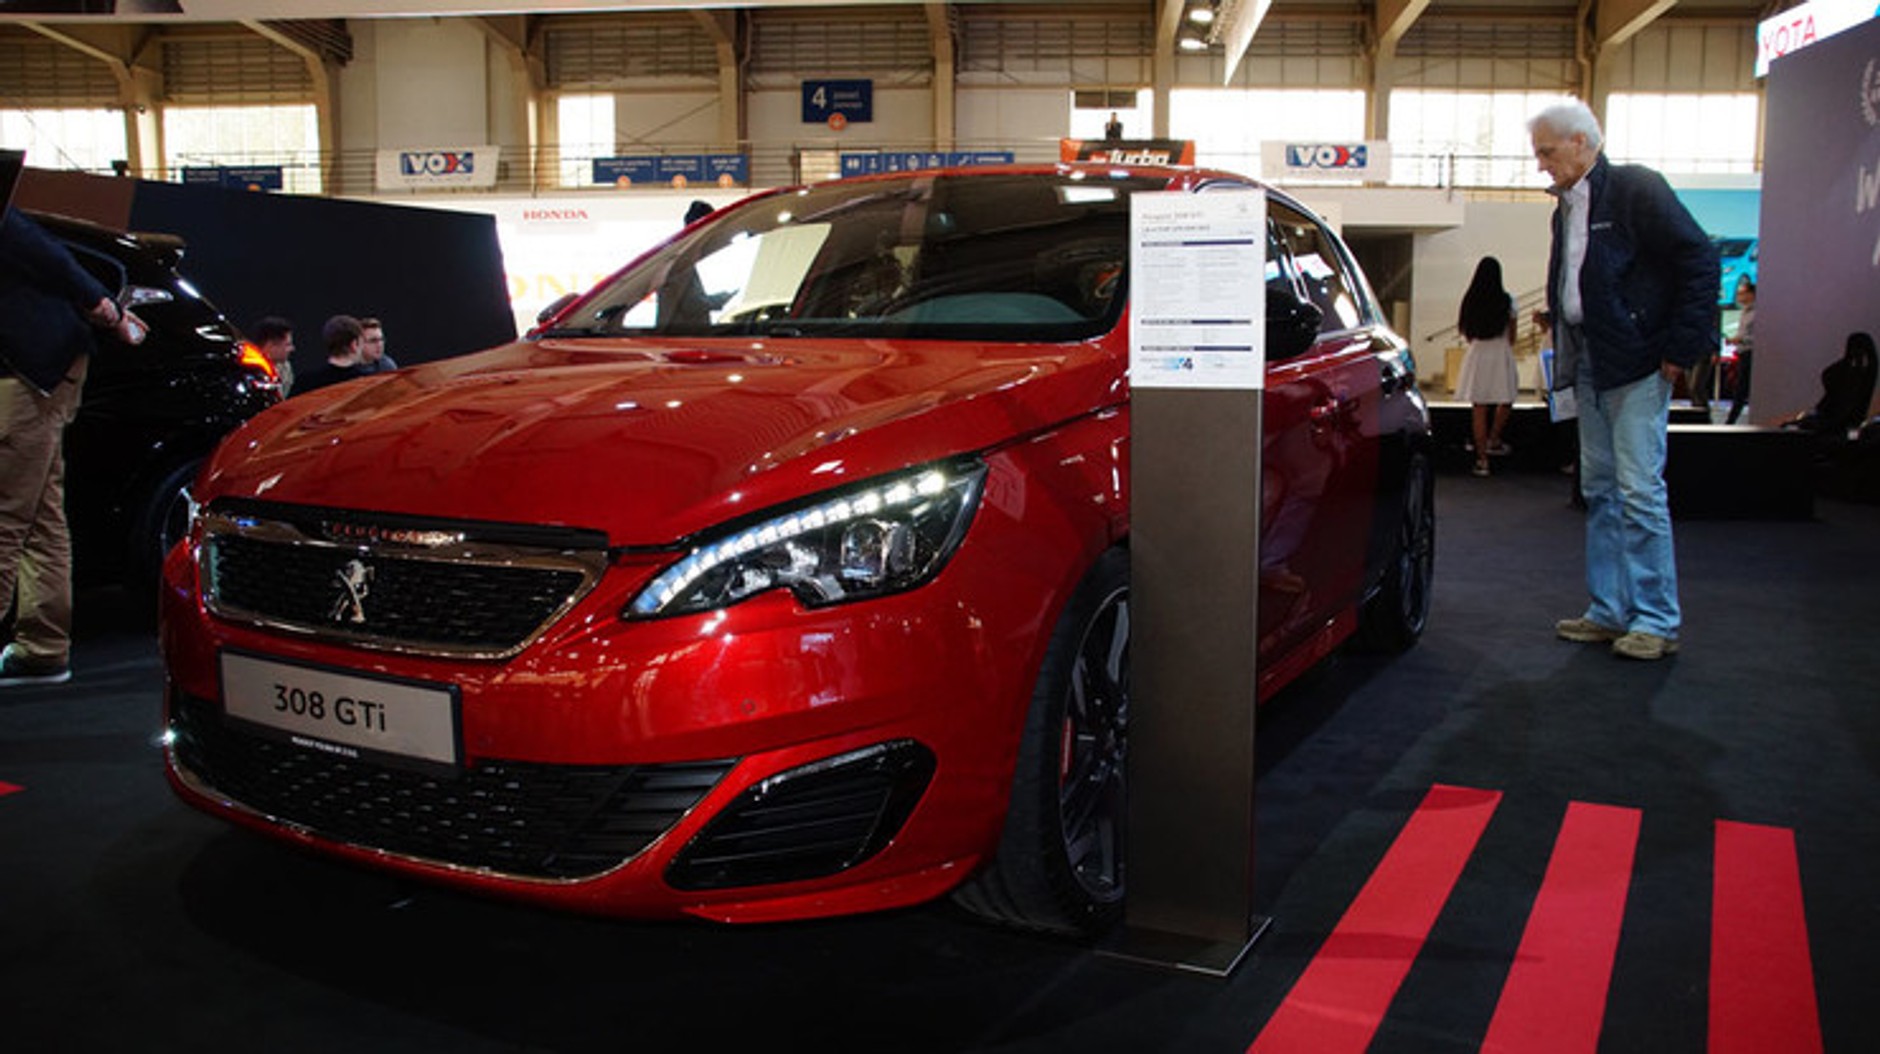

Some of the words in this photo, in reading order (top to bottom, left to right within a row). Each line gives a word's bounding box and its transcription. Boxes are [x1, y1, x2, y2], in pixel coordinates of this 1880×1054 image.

[812, 86, 827, 109] 4
[523, 208, 588, 221] HONDA
[274, 683, 325, 720] 308
[334, 697, 386, 732] GTi
